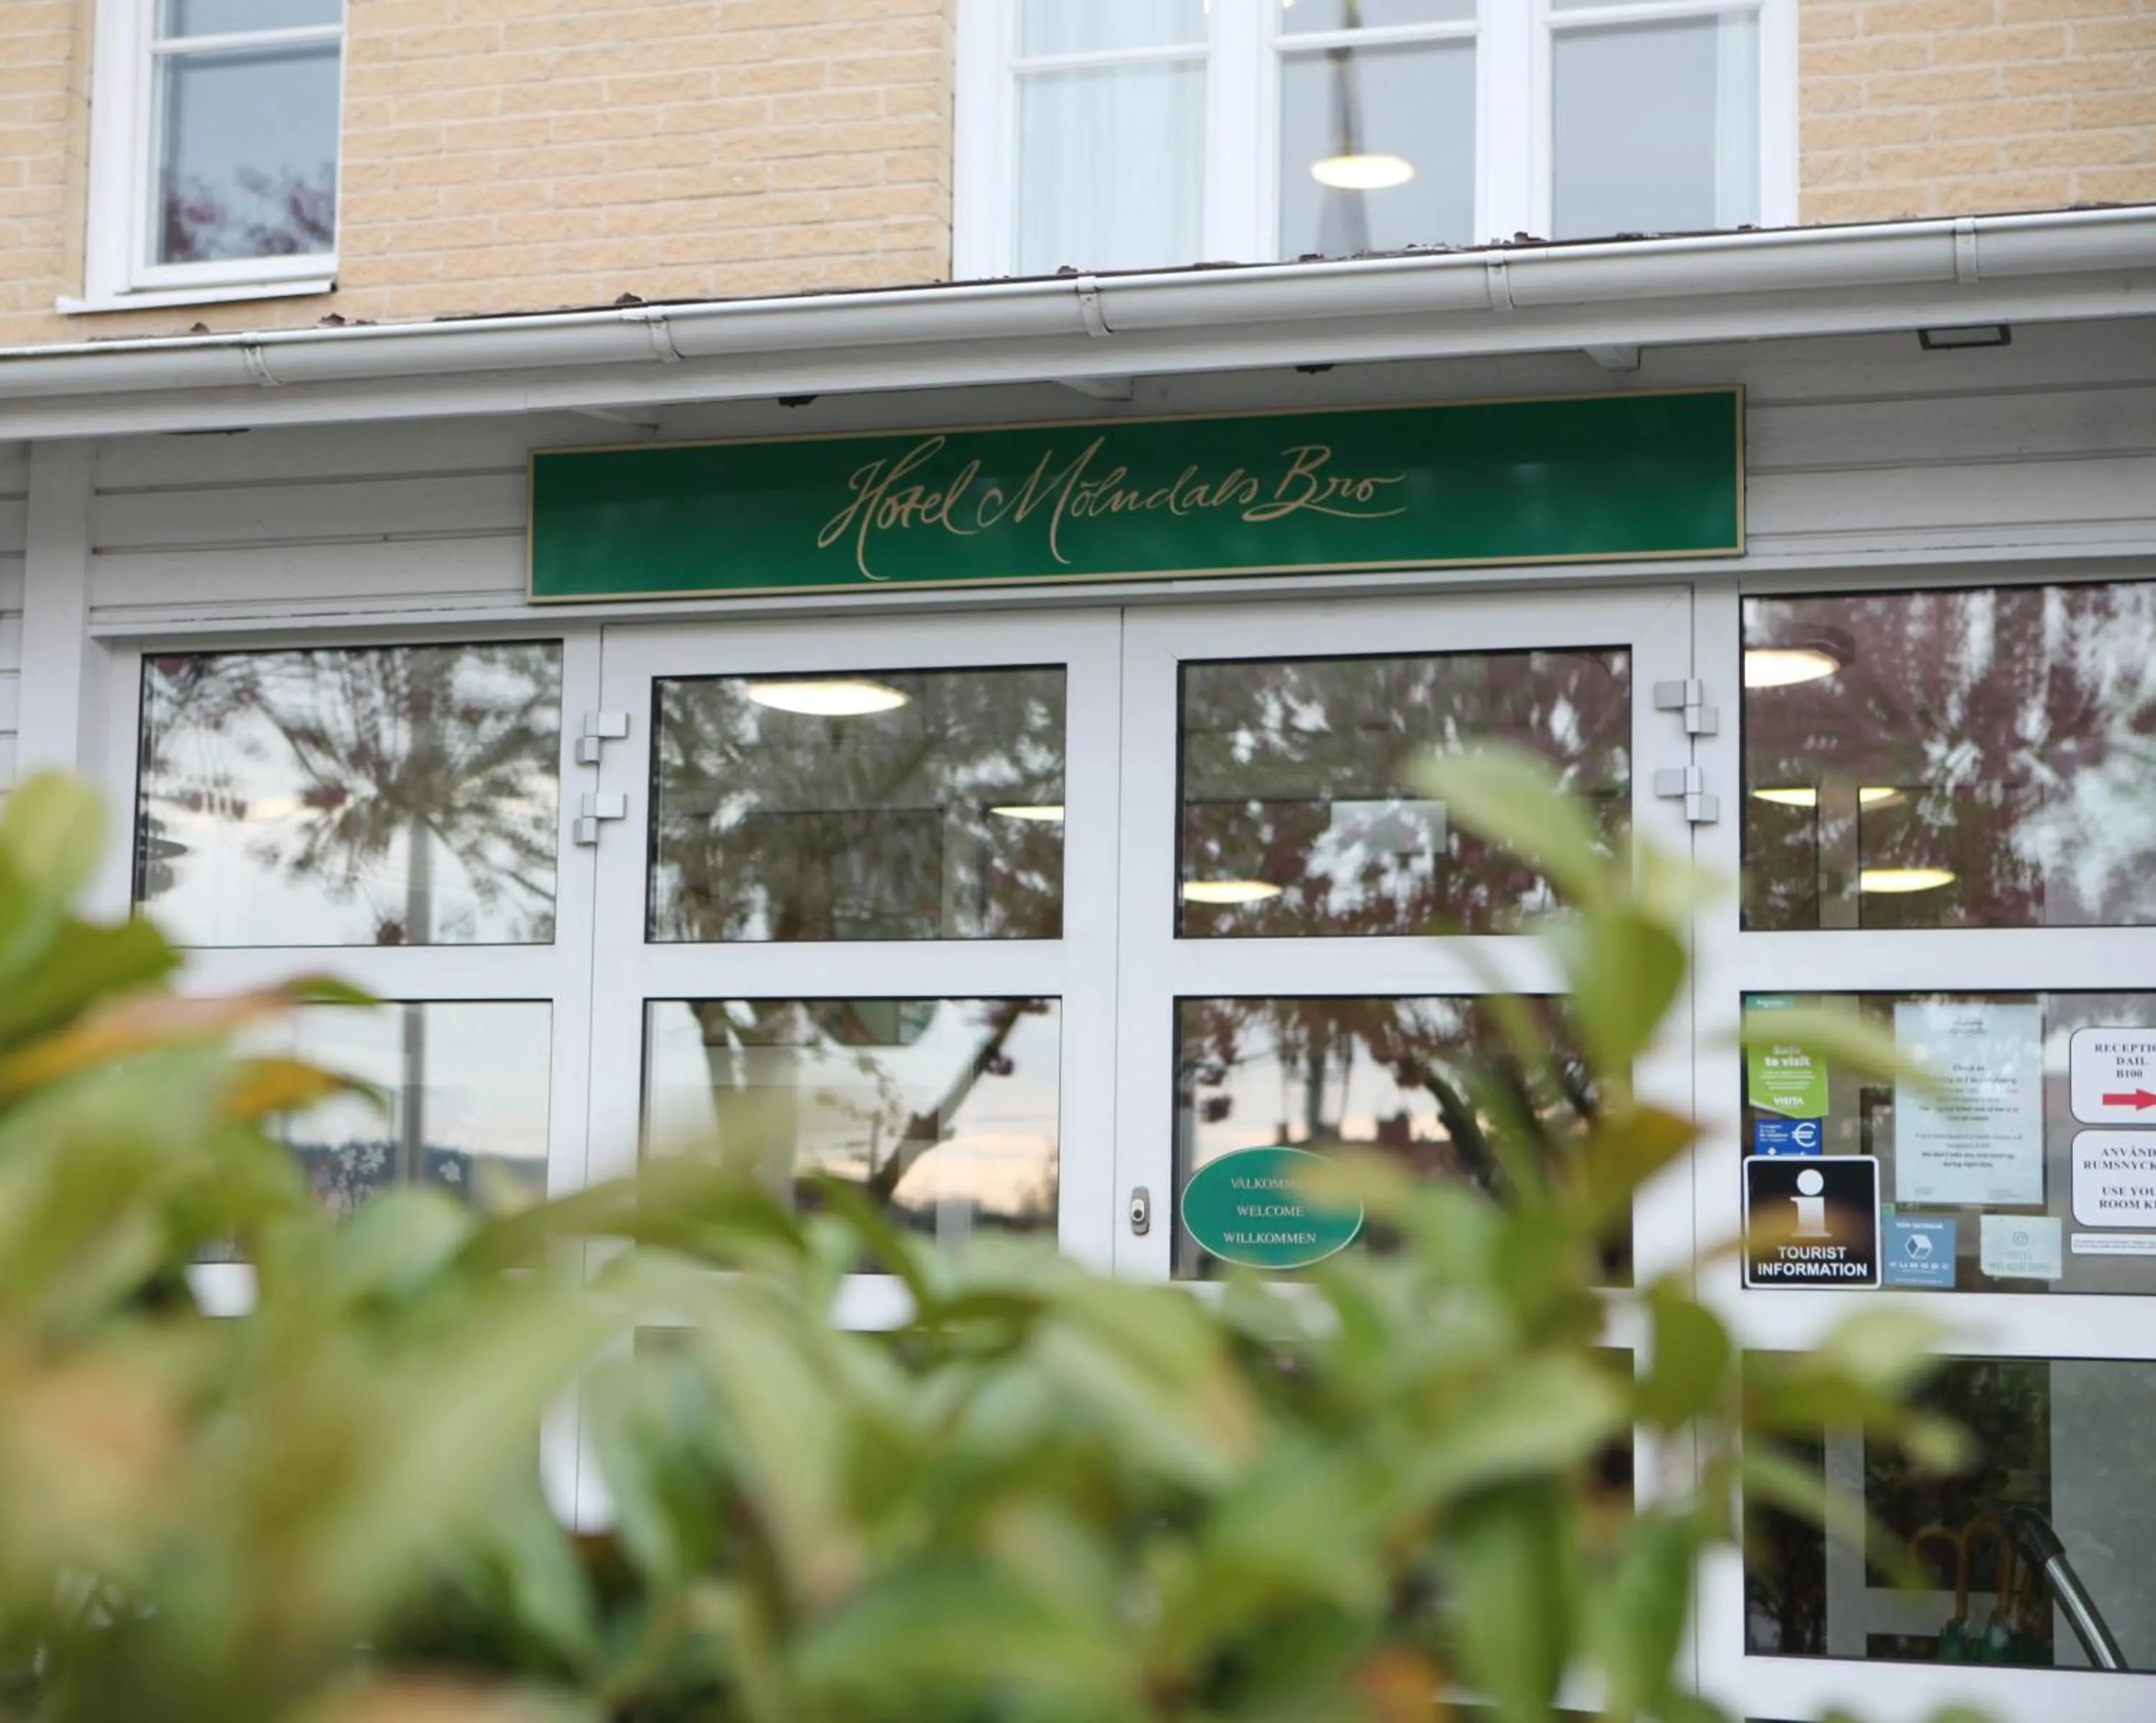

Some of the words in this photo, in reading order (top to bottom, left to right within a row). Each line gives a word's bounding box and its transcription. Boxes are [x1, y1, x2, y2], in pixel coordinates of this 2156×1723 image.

[816, 435, 981, 581] Hotel
[1242, 444, 1408, 522] Bro
[1764, 1056, 1779, 1067] to
[1782, 1055, 1810, 1067] visit
[2116, 1057, 2148, 1066] DAIL
[2116, 1069, 2143, 1078] B100
[1230, 1175, 1304, 1190] VÄLKOMM
[2102, 1186, 2126, 1196] USE
[2099, 1199, 2139, 1209] ROOM
[1237, 1206, 1305, 1217] WELCOME
[1223, 1232, 1317, 1244] WILLKOMMEN
[1777, 1246, 1847, 1260] TOURIST
[1758, 1262, 1867, 1277] INFORMATION
